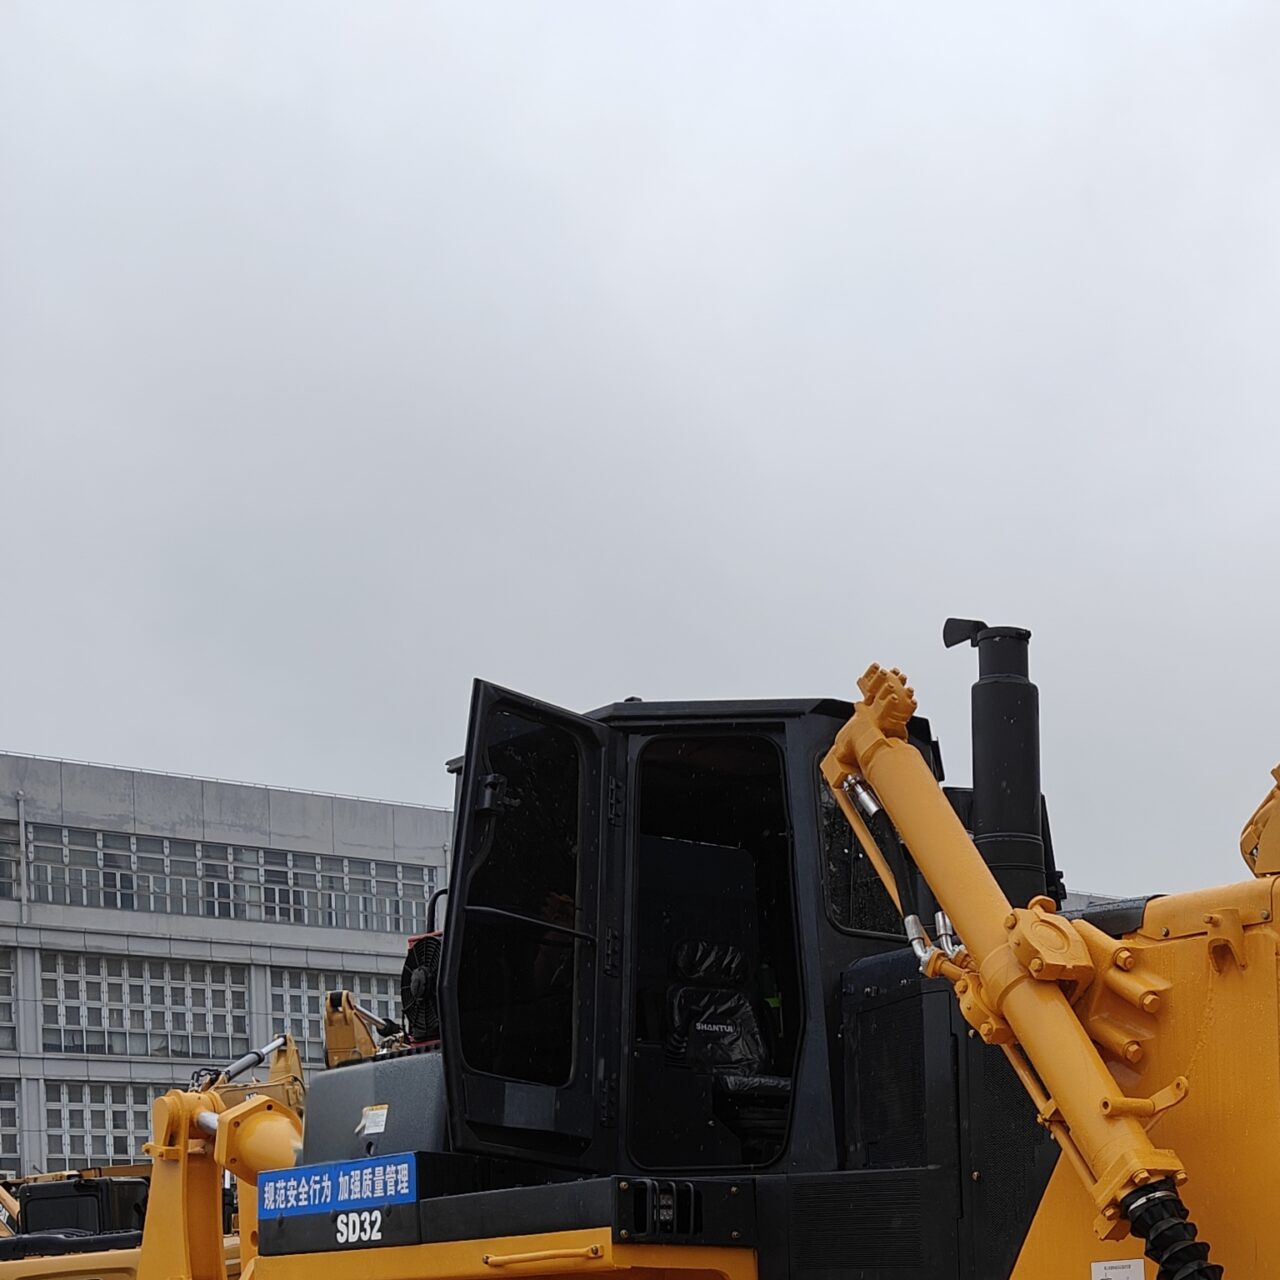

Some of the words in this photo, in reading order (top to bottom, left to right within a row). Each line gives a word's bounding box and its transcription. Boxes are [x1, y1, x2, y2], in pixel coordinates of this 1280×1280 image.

[695, 1022, 733, 1033] SHANTUI
[263, 1173, 332, 1210] 规范安全行为
[338, 1163, 410, 1201] 加强质量管理
[336, 1209, 382, 1244] SD32
